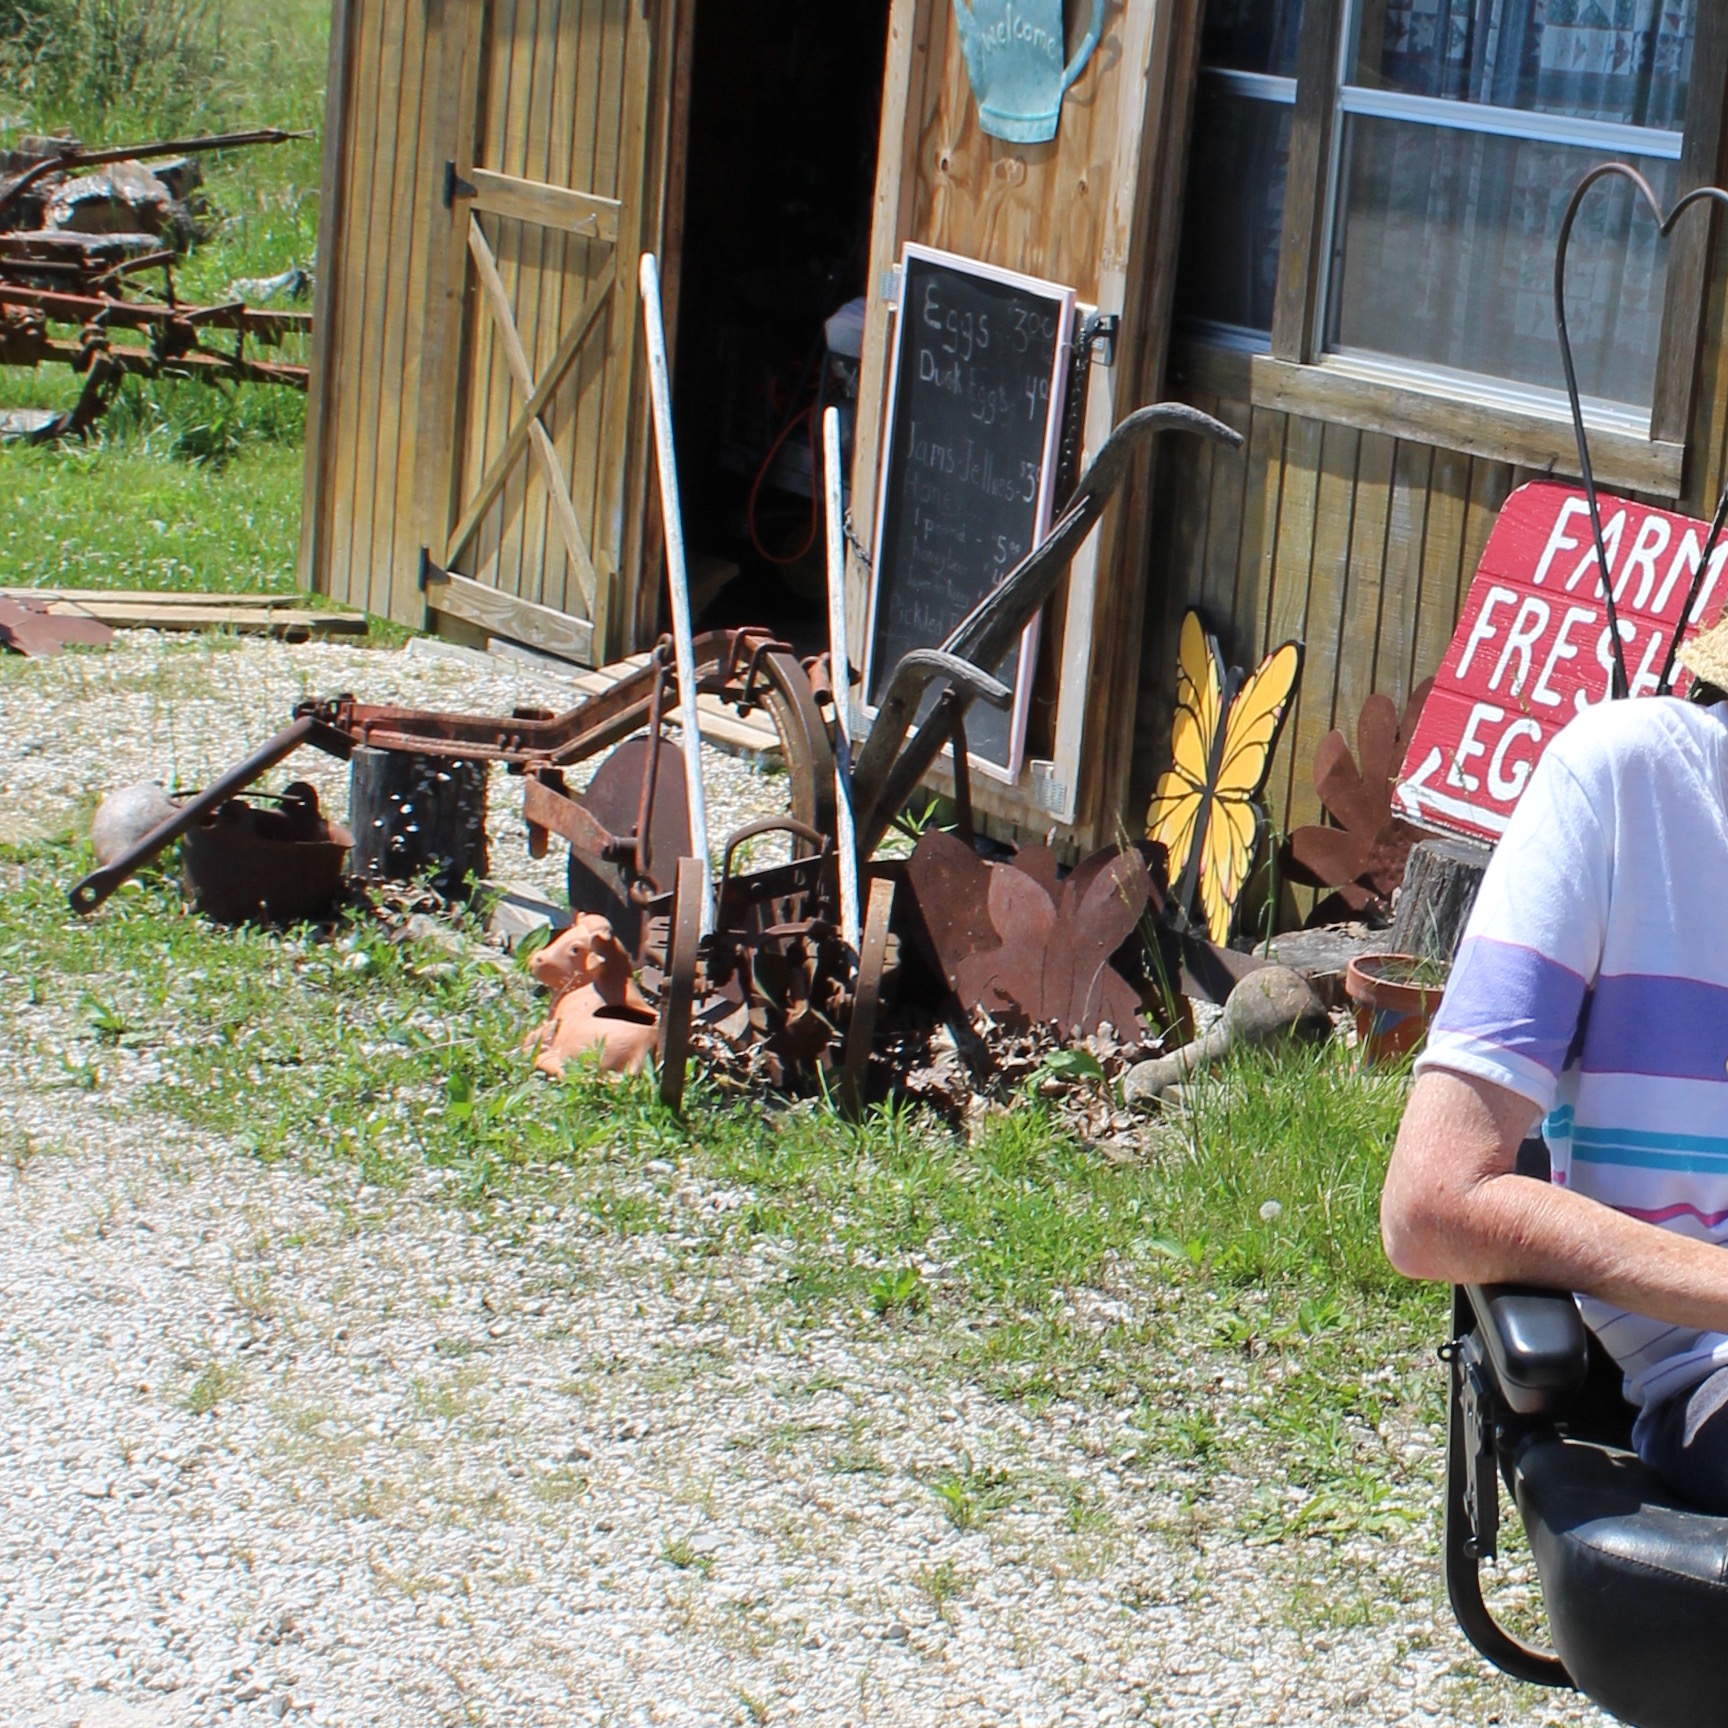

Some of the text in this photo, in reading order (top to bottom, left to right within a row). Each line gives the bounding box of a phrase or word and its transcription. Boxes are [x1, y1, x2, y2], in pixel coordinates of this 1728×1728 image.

[981, 2, 1056, 60] welcome
[923, 282, 989, 362] Eggs
[919, 348, 961, 396] Duck
[1445, 702, 1543, 802] EG
